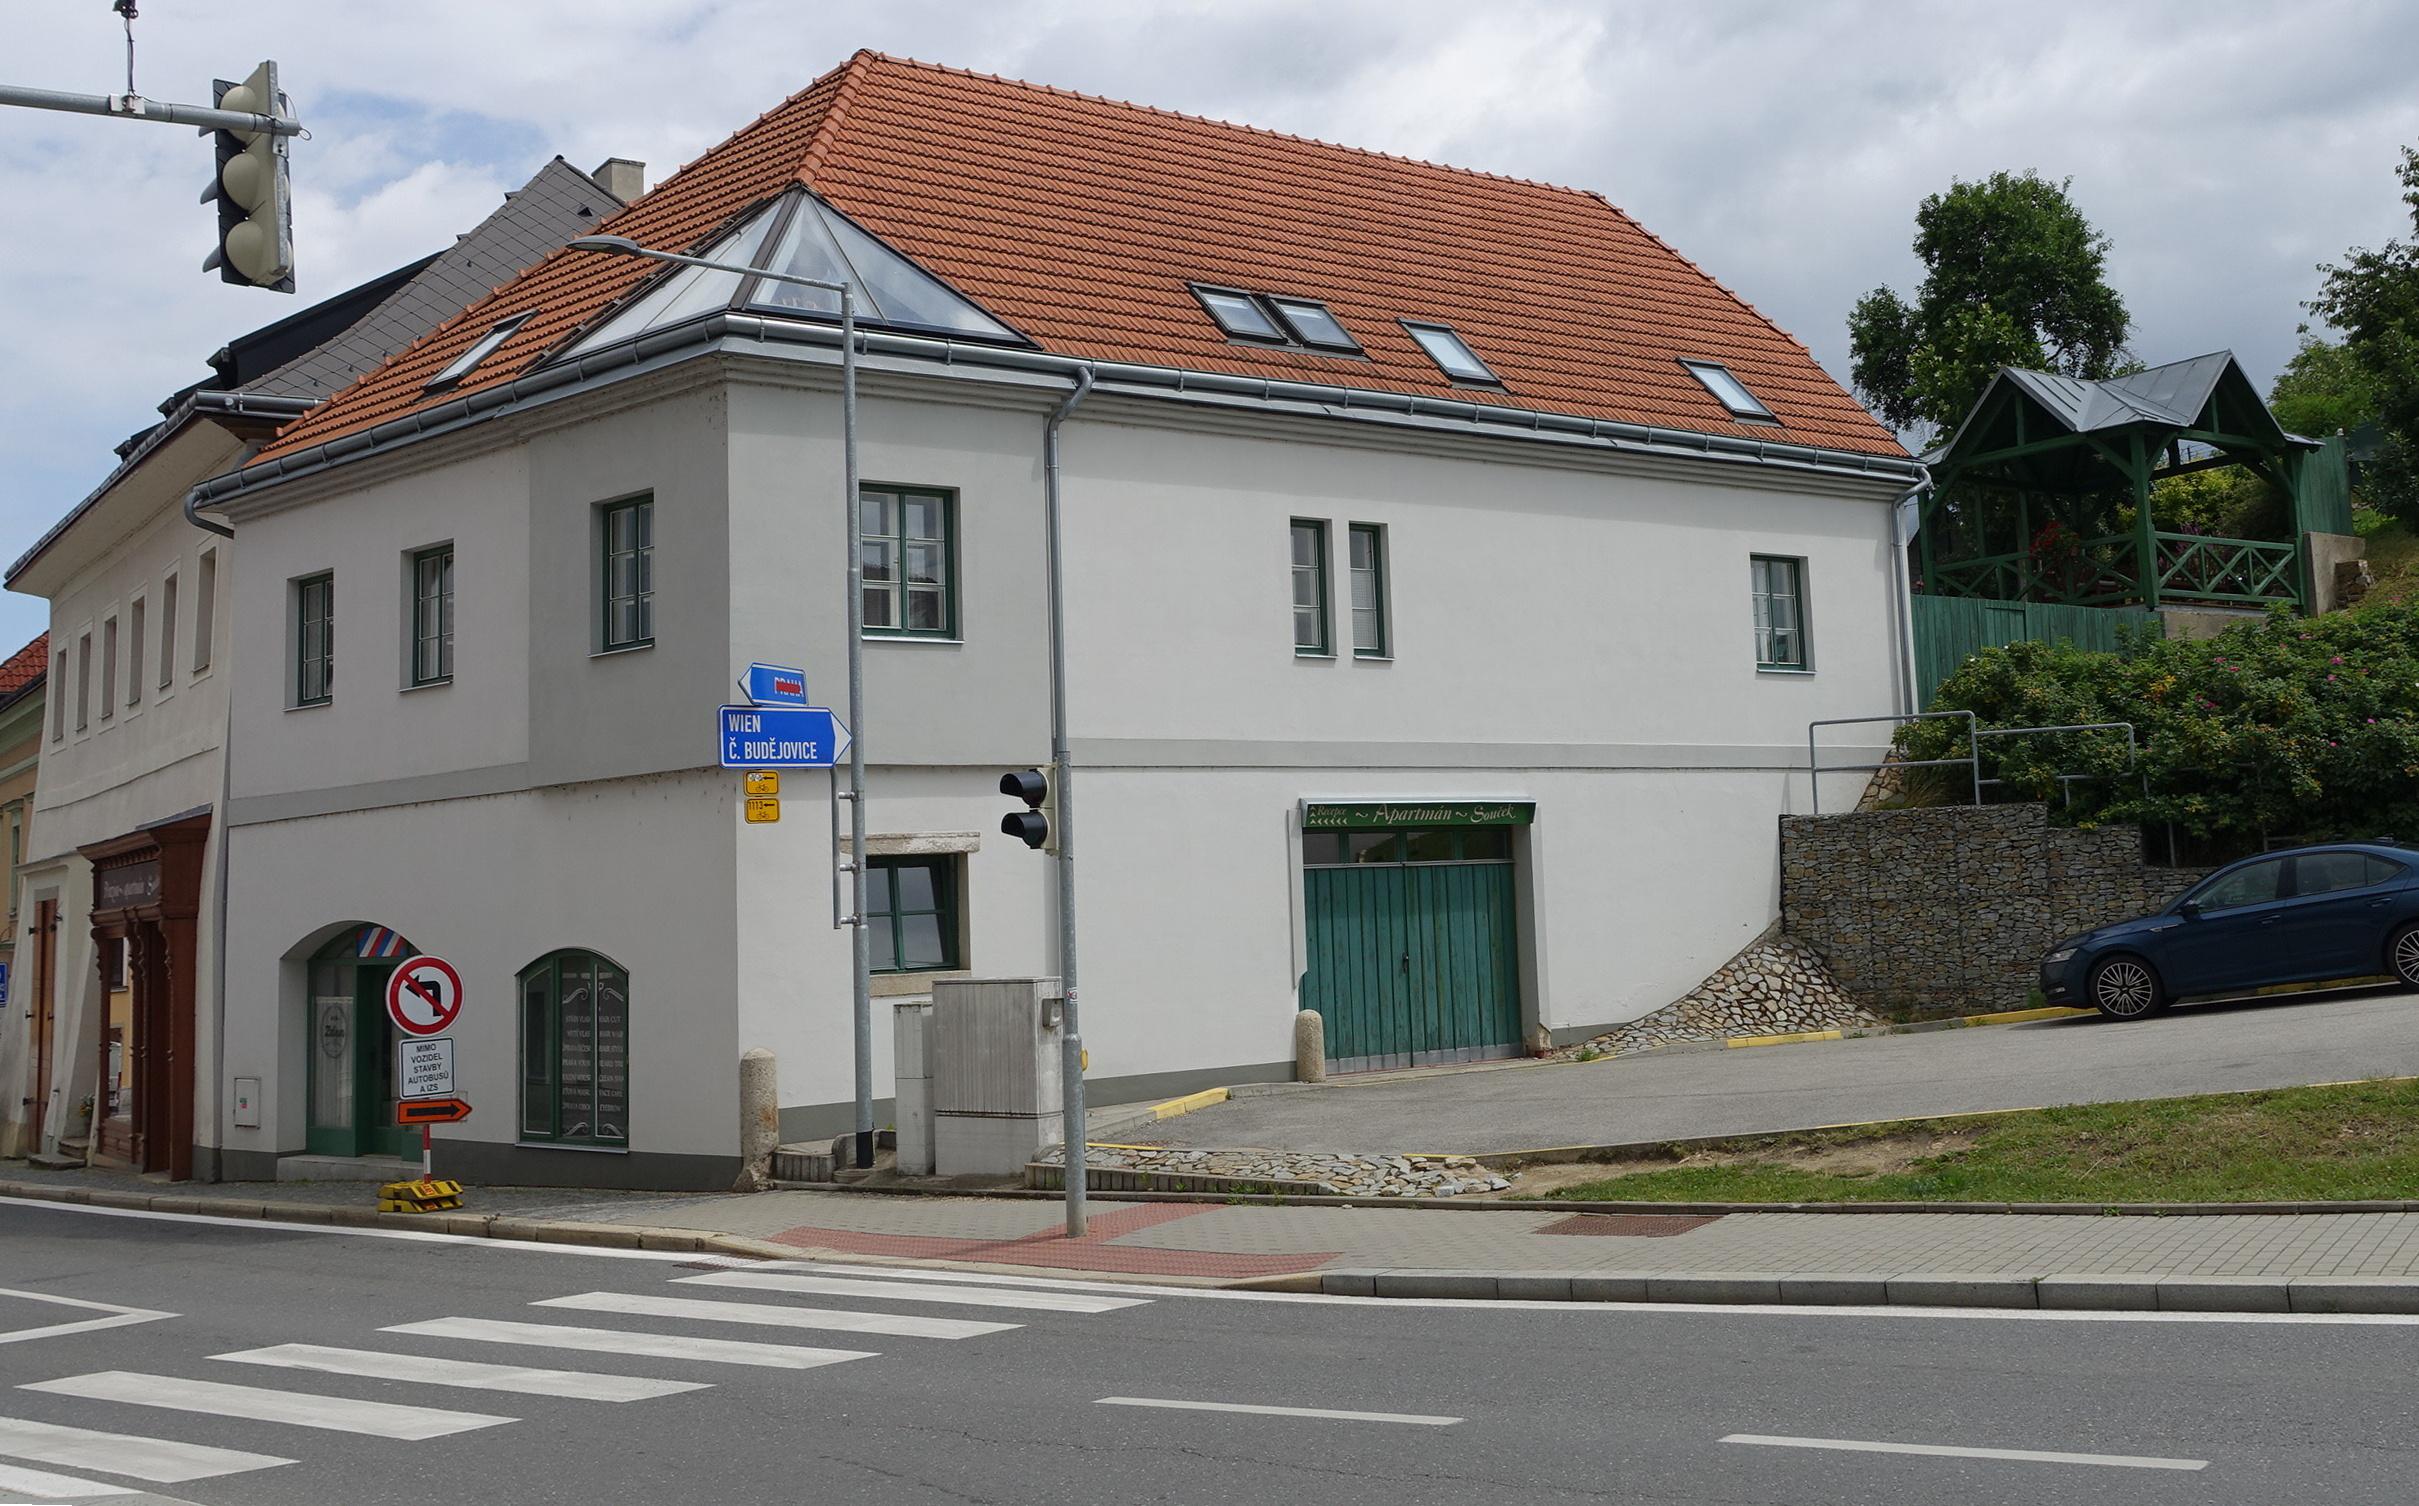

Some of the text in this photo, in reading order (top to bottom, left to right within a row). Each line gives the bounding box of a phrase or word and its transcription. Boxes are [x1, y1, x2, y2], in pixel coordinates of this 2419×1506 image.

[728, 714, 761, 733] WIEN
[729, 737, 818, 760] Č. BUDĚJOVICE
[1373, 803, 1453, 824] Apartmán
[1470, 804, 1517, 823] Souček
[416, 1043, 437, 1052] MIMO
[410, 1053, 444, 1063] VOZIDEL
[413, 1063, 442, 1074] STAVBY
[408, 1071, 449, 1084] AUTOBUSŮ
